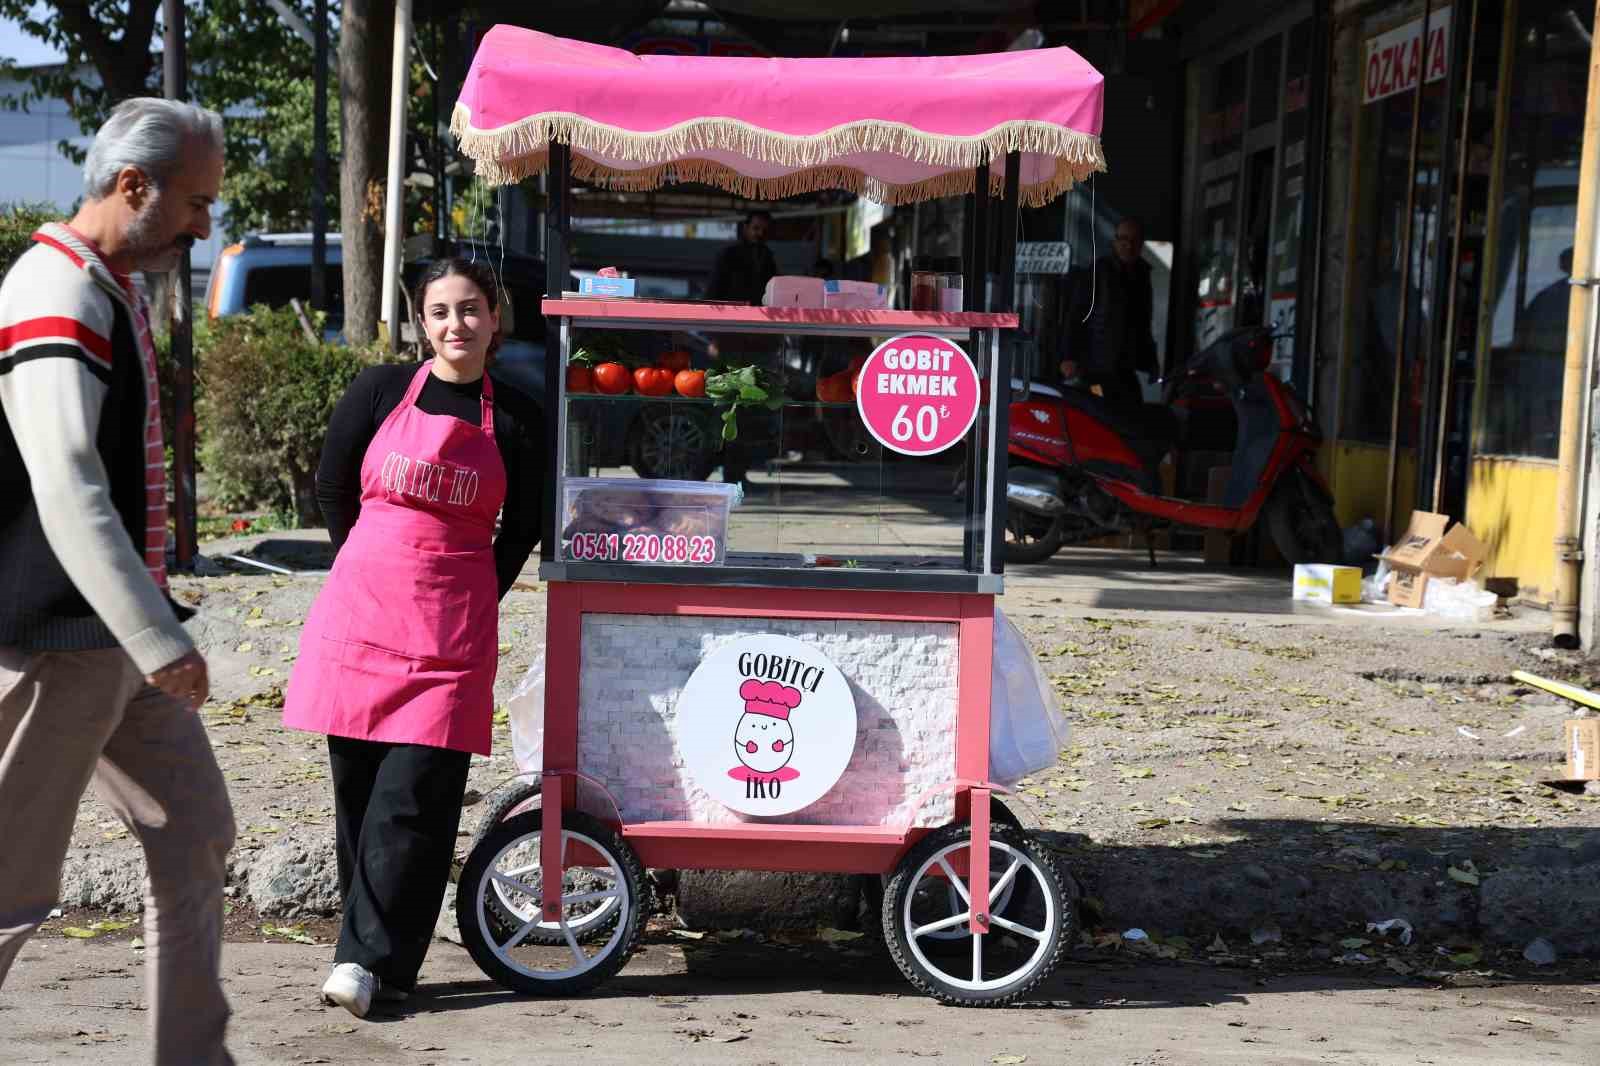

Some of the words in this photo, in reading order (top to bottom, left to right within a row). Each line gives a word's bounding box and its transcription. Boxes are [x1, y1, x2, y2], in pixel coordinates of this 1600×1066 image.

[883, 347, 954, 372] GOBİT
[877, 373, 958, 397] EKMEK
[571, 533, 619, 560] 0541
[622, 533, 661, 562] 220
[662, 534, 688, 563] 88
[689, 535, 716, 564] 23
[746, 774, 781, 800] İKO
